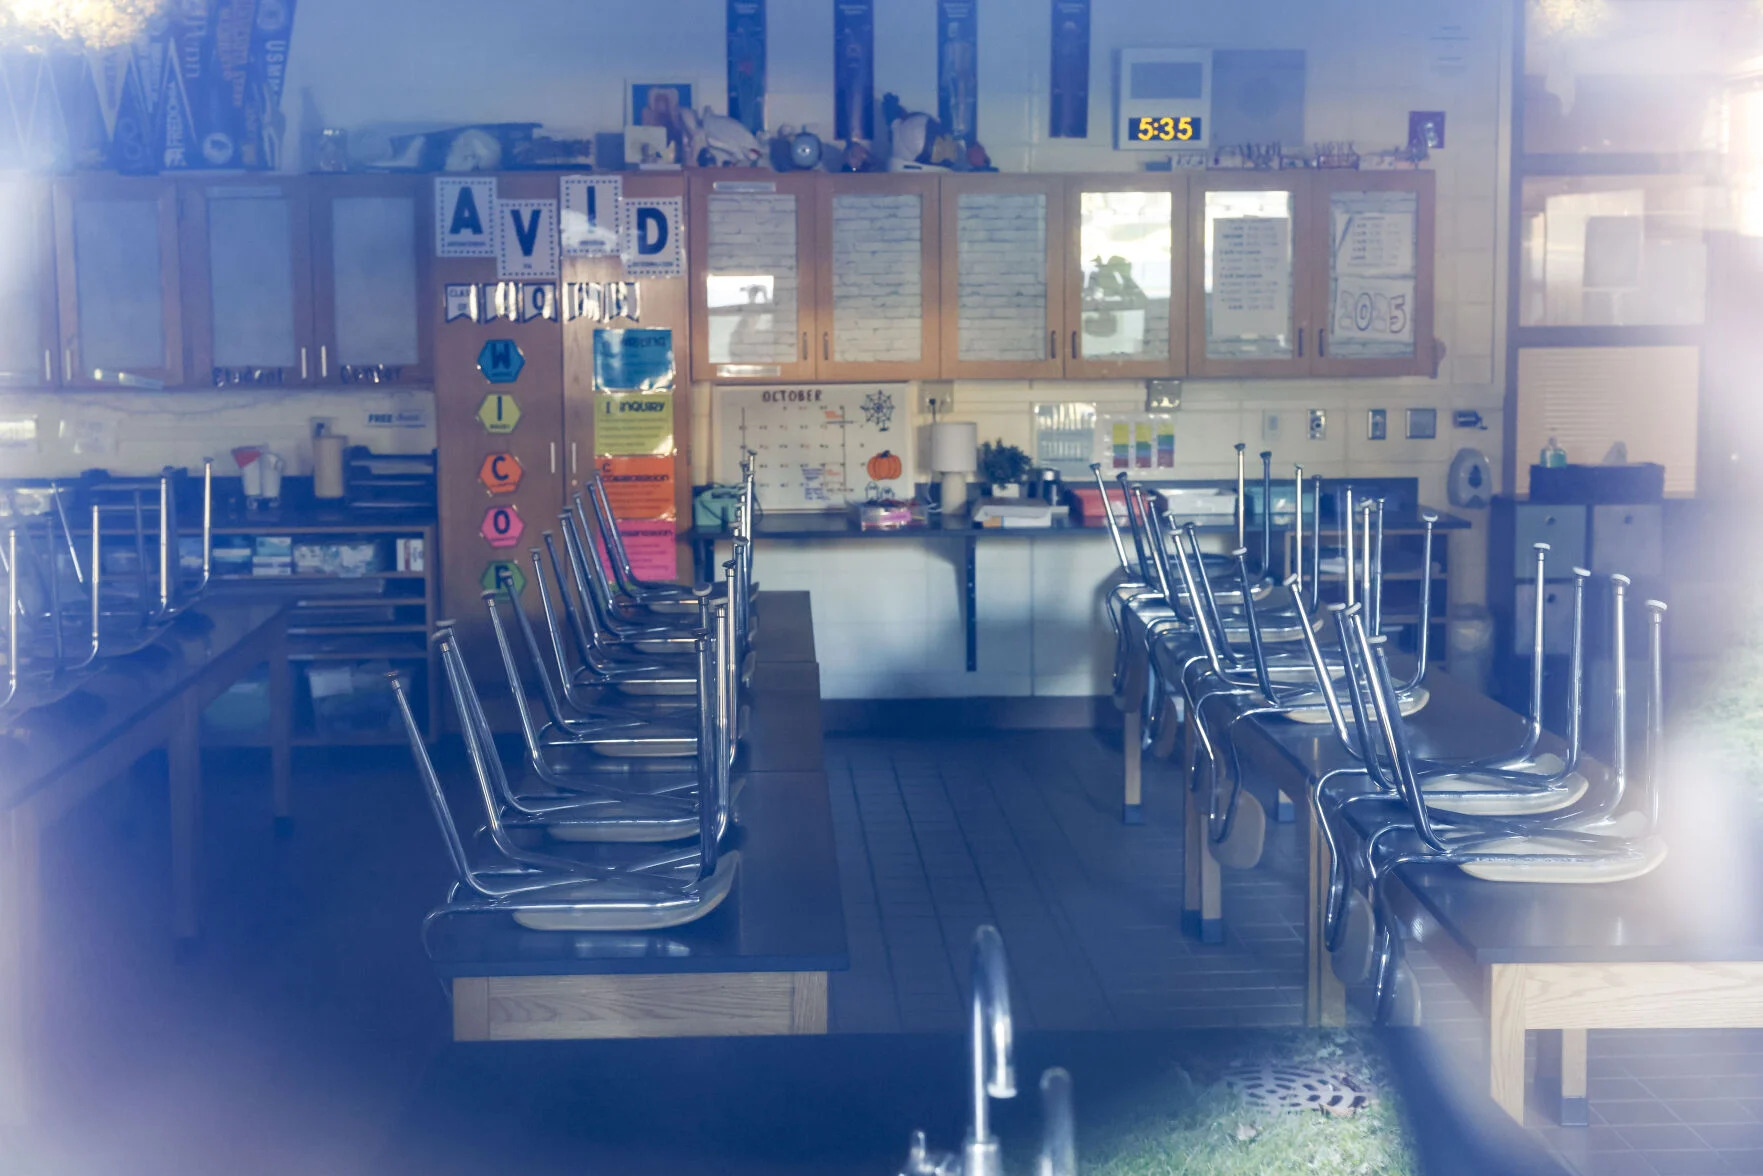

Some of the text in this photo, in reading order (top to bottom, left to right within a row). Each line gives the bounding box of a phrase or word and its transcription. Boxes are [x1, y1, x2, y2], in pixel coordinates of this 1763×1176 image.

[1138, 117, 1193, 141] 5:35
[1339, 290, 1407, 333] 2025
[762, 389, 822, 402] OCTOBER
